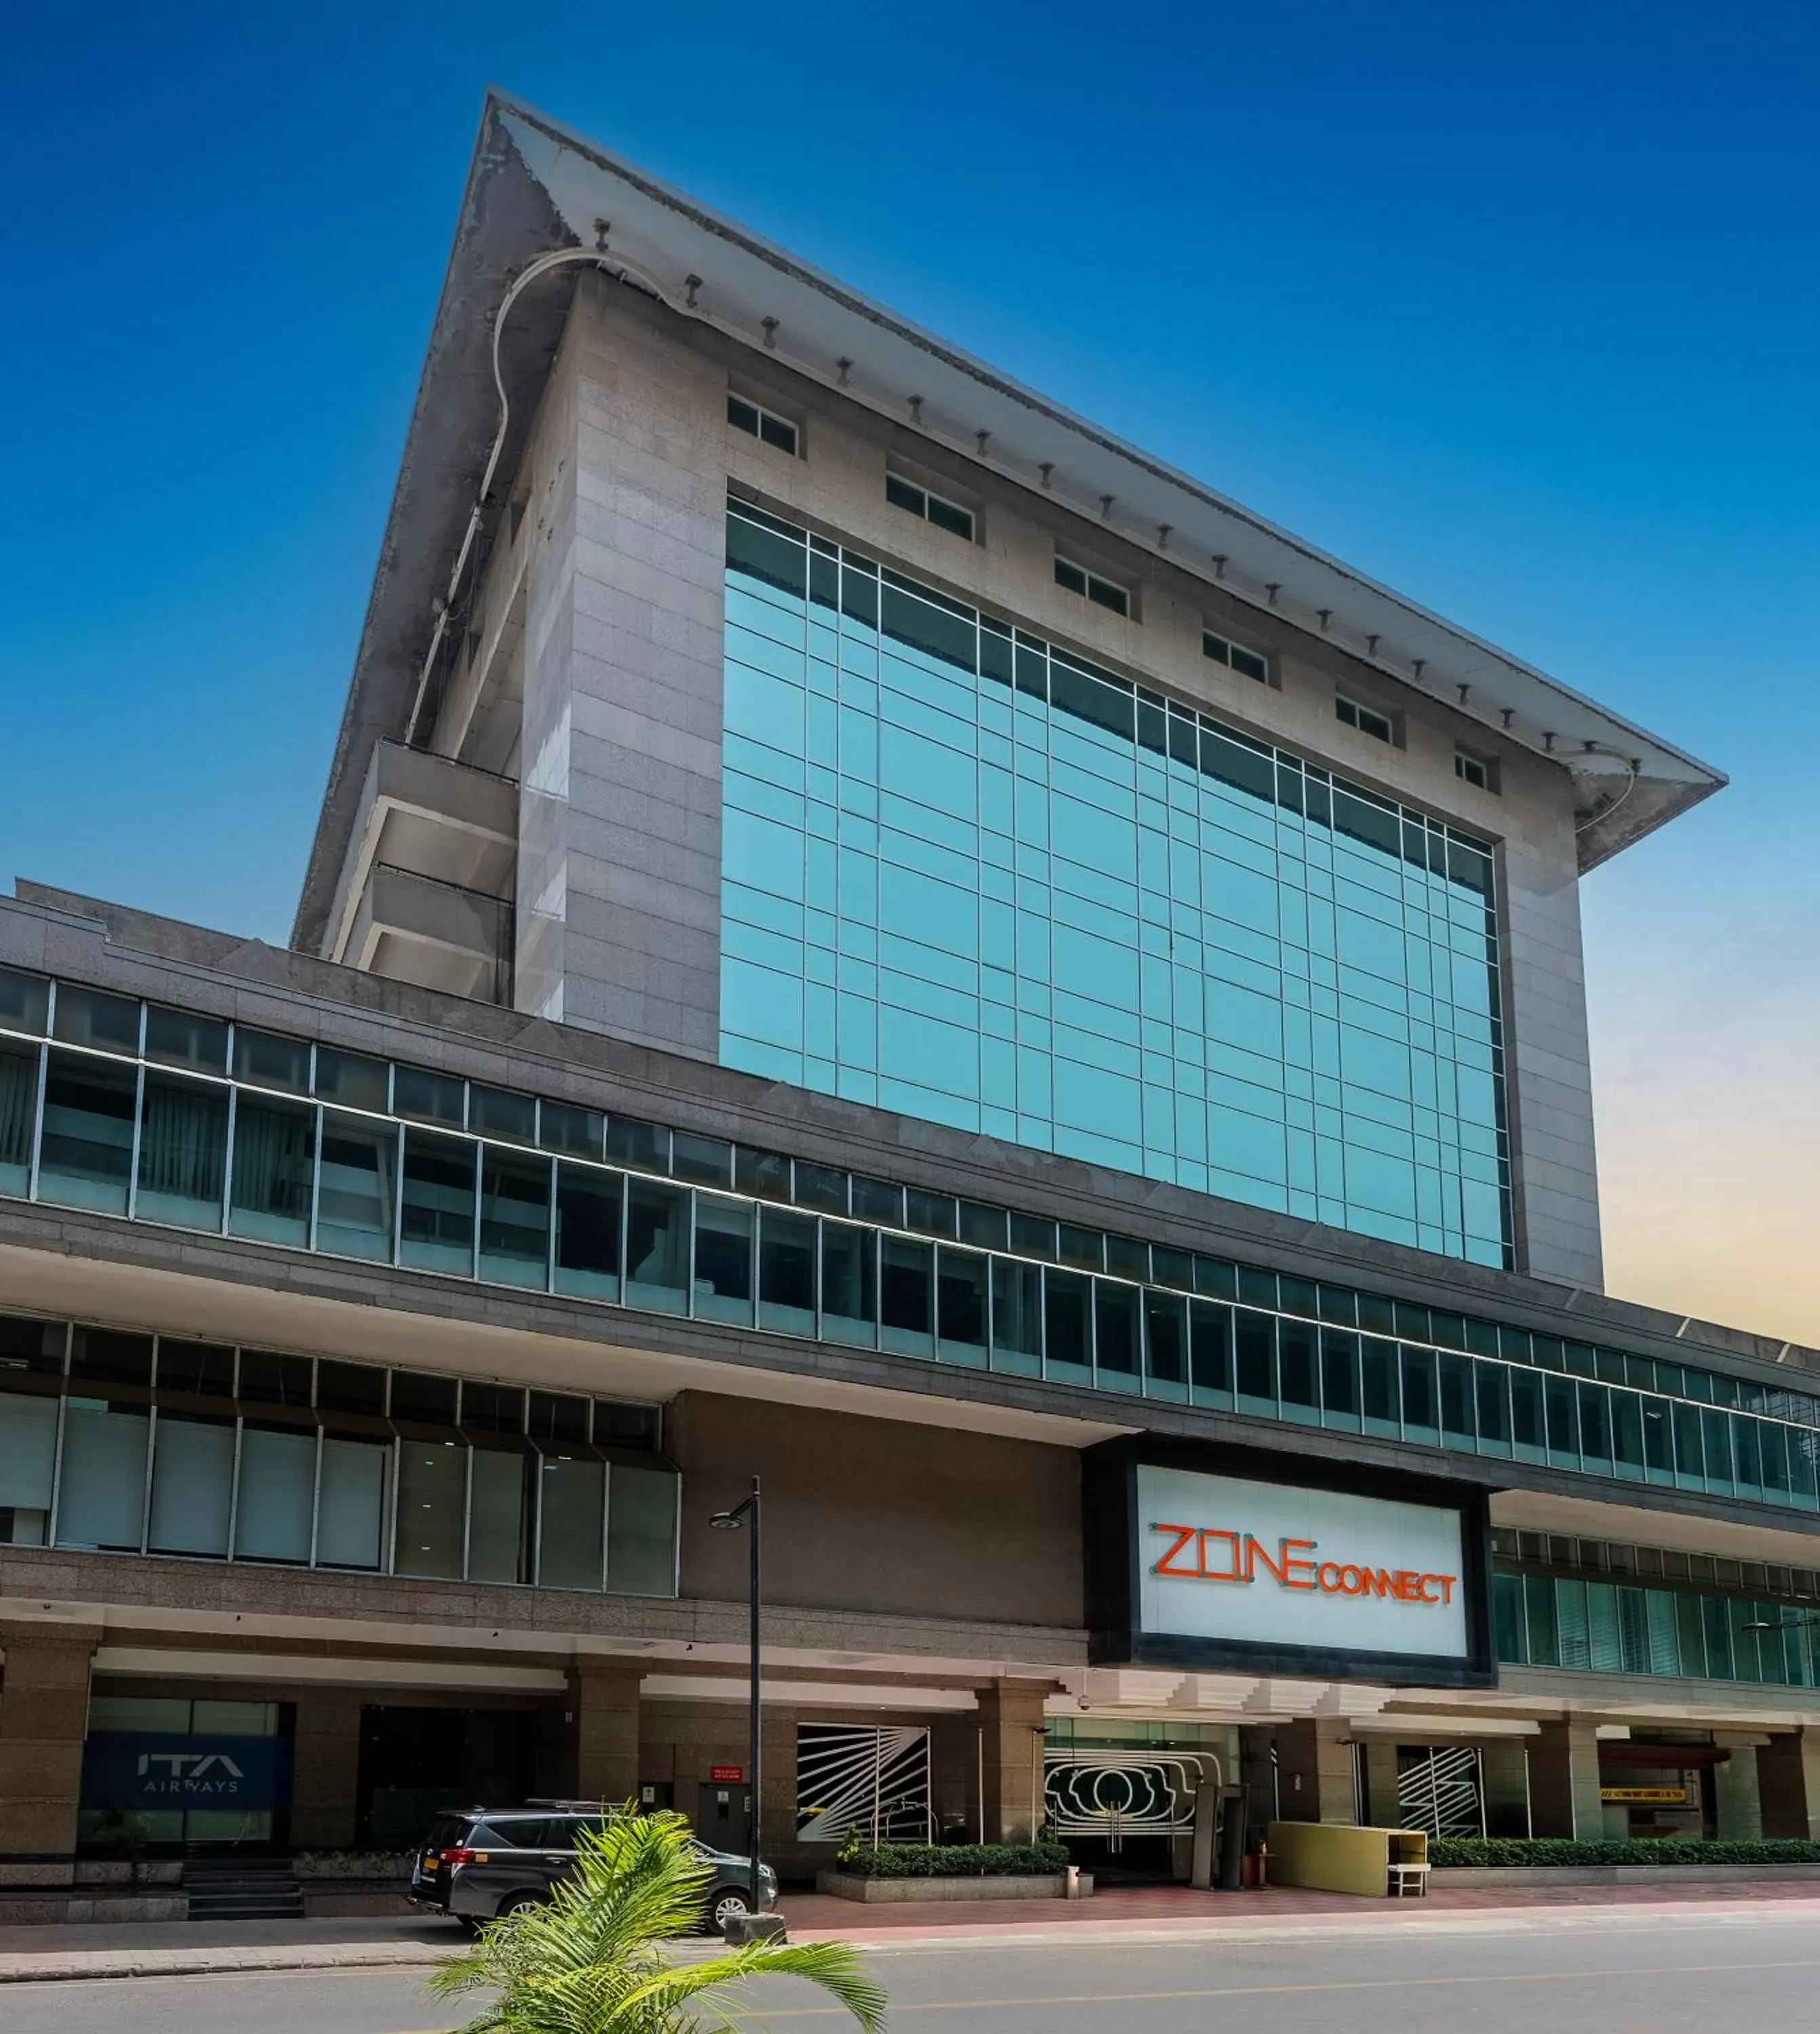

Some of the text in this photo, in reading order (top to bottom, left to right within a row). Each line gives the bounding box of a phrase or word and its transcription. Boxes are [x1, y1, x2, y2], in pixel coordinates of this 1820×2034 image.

[1149, 1521, 1457, 1604] ZONE CONNECT
[138, 1753, 244, 1777] ITA
[143, 1780, 239, 1793] AIRWAYS
